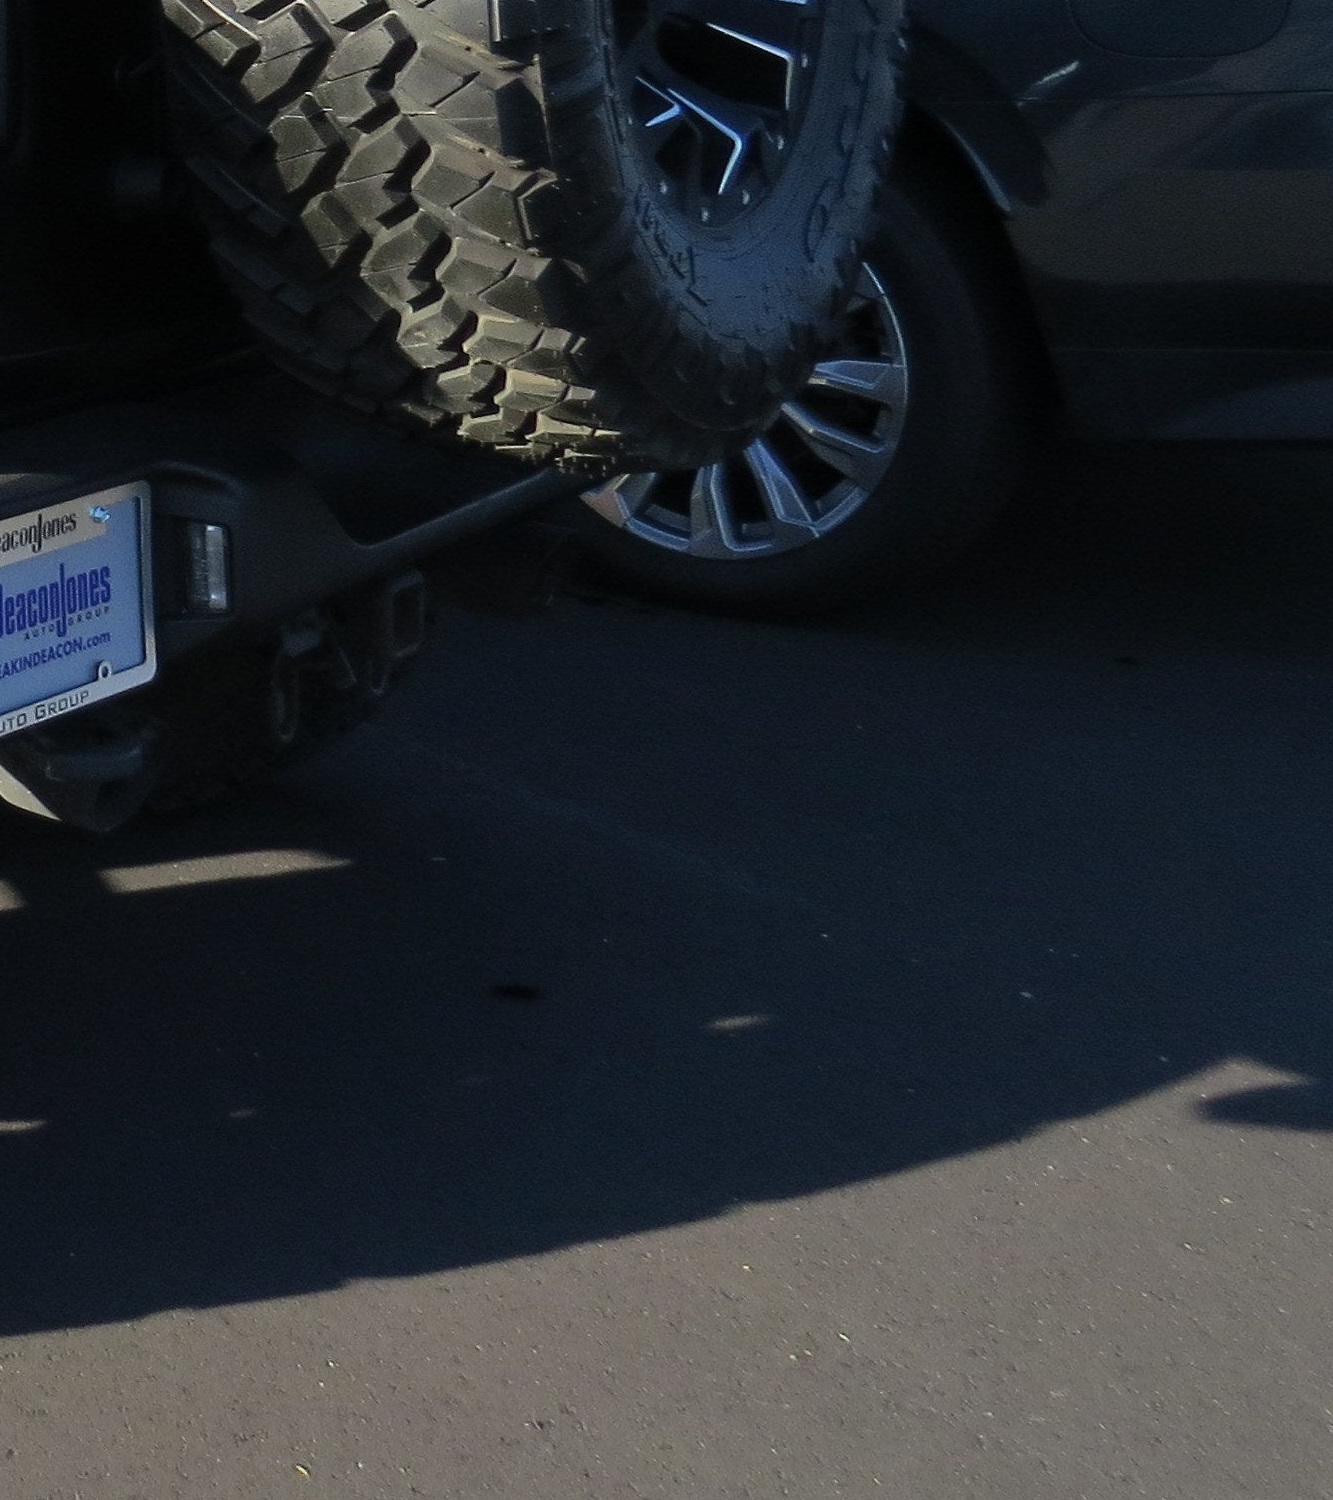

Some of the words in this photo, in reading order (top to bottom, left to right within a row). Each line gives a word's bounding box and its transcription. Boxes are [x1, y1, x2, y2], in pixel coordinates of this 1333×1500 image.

[24, 624, 56, 641] AUTO
[68, 605, 111, 627] GROUP
[34, 690, 90, 722] GROUP
